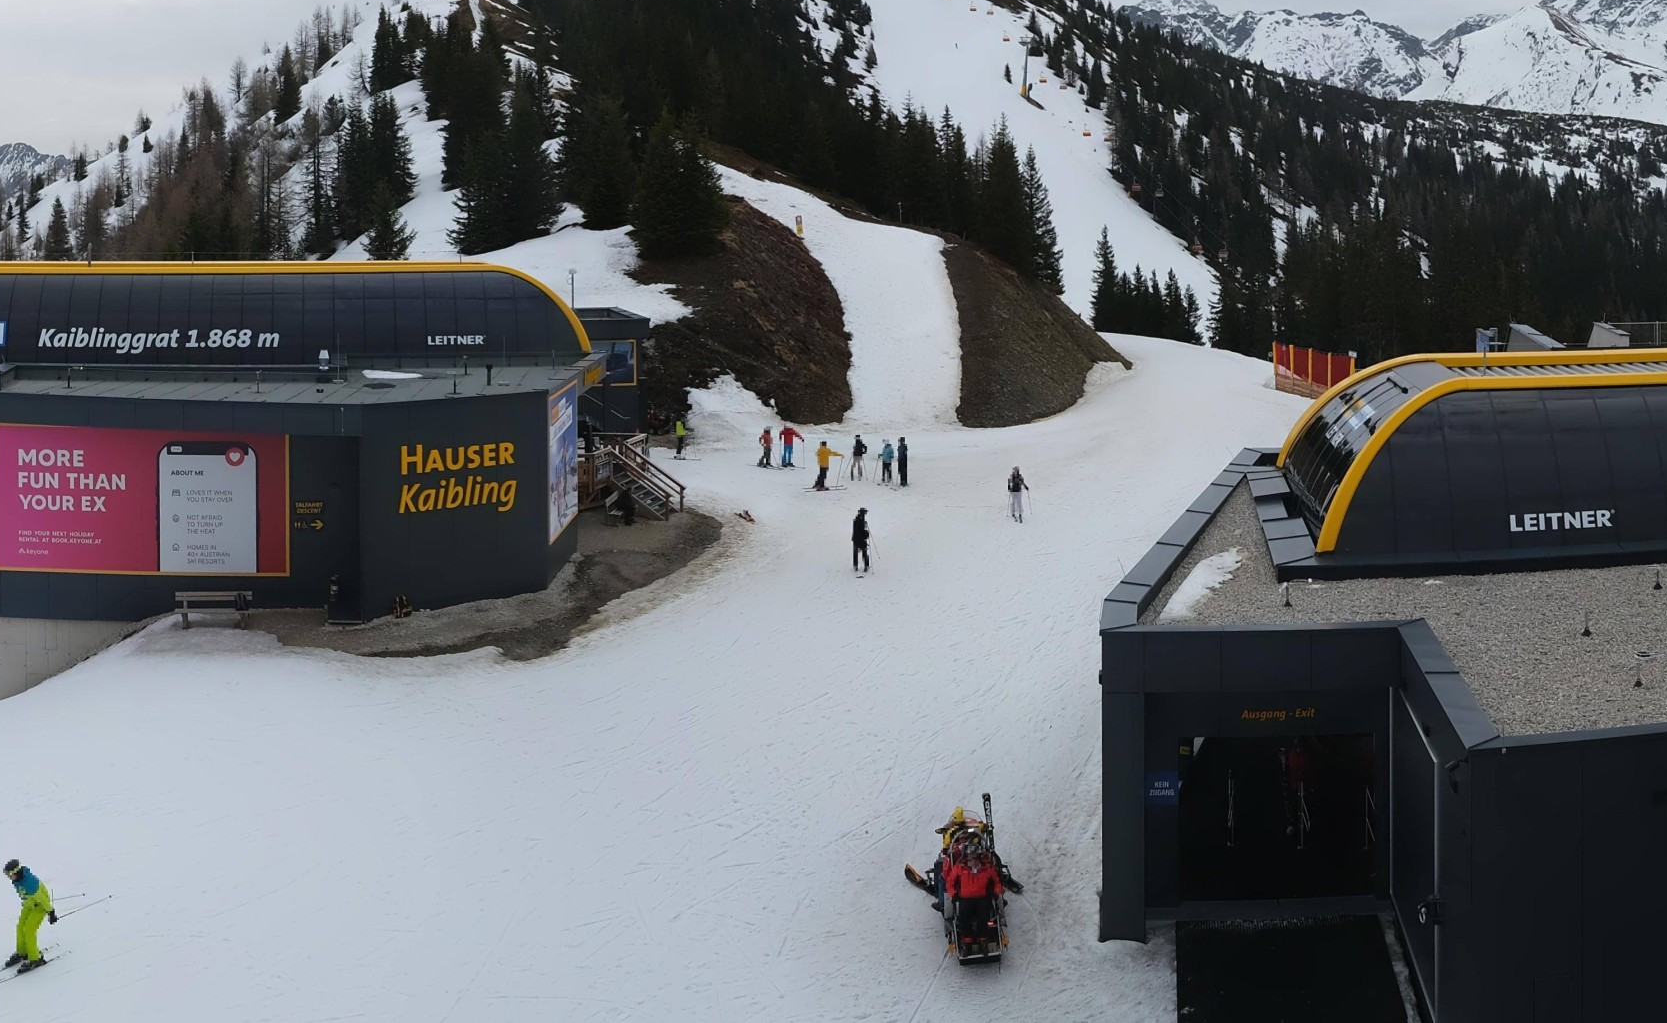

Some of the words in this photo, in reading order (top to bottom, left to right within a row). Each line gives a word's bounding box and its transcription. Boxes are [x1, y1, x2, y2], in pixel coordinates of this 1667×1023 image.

[38, 327, 179, 354] Kaiblinggrat
[185, 328, 251, 348] 1.868
[257, 331, 280, 348] m
[427, 335, 484, 346] LEITNER
[18, 449, 84, 467] MORE
[400, 442, 515, 475] HAUSER
[18, 472, 59, 489] FUN
[67, 473, 126, 490] THAN
[19, 494, 74, 511] YOUR
[81, 496, 106, 512] EX
[398, 475, 517, 513] Kaibling
[1509, 510, 1613, 532] LEITNER
[1241, 709, 1287, 721] Ausgang
[1295, 708, 1316, 718] Exit
